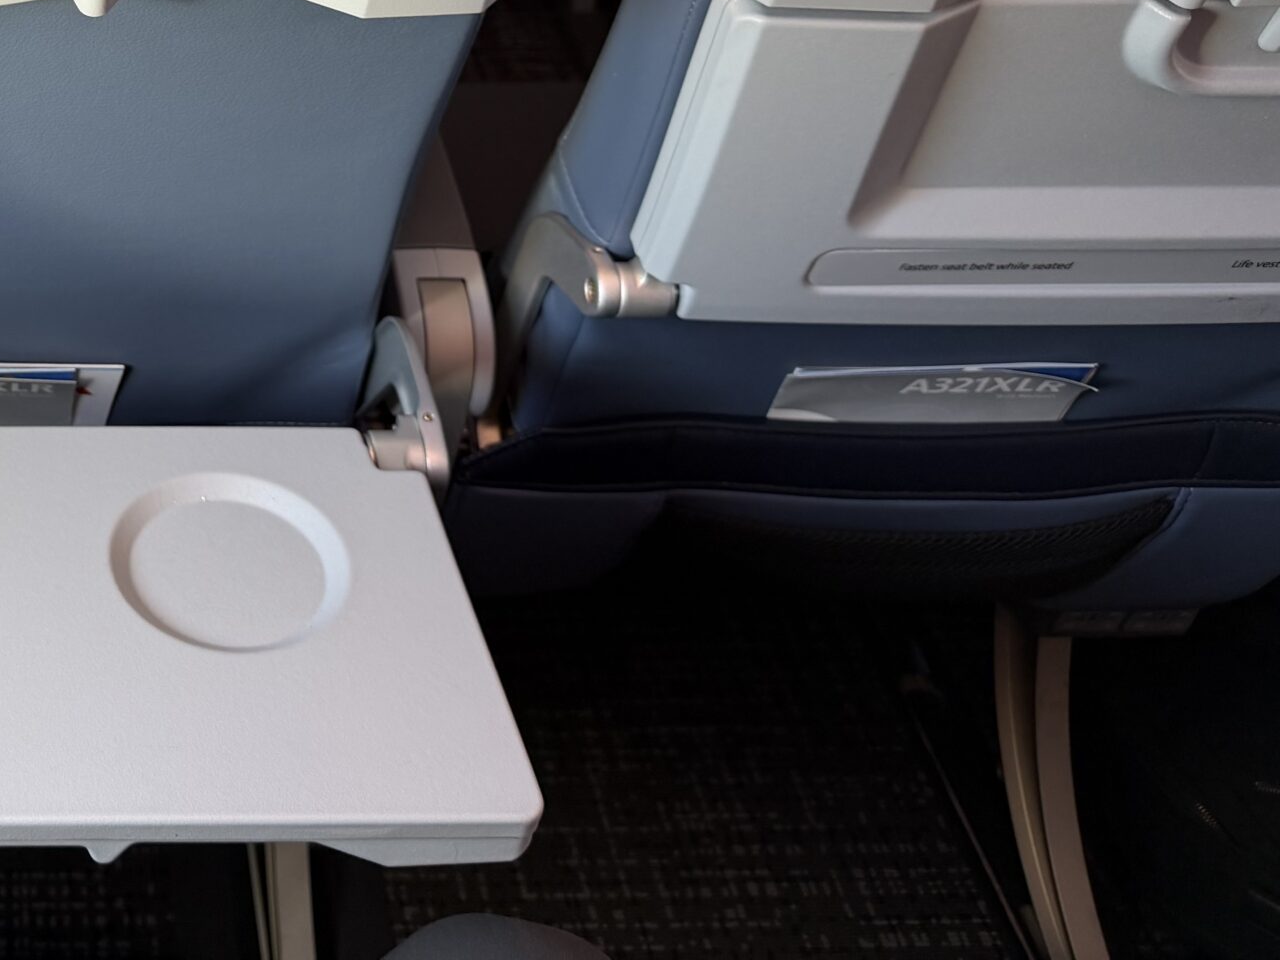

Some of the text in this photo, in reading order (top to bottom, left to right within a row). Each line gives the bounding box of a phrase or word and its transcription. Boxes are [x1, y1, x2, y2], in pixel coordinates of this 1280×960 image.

[898, 261, 1074, 271] Fasten seat belt while seated
[1232, 259, 1255, 268] Life
[899, 377, 1066, 393] A321XLR
